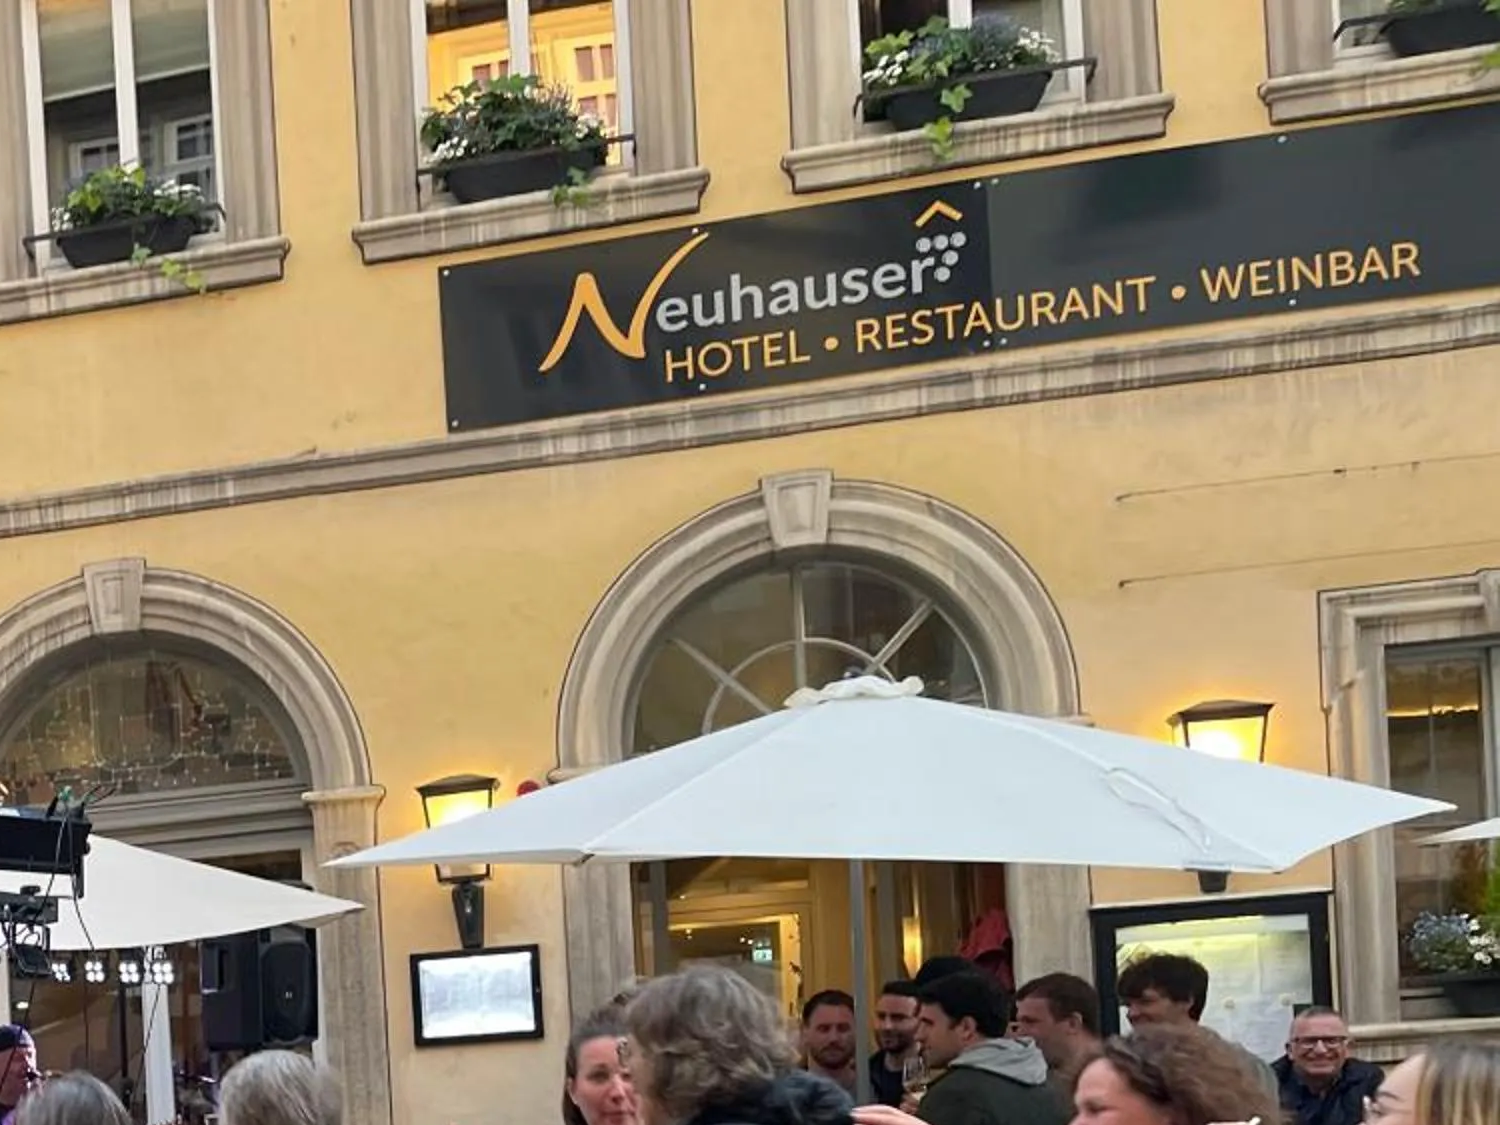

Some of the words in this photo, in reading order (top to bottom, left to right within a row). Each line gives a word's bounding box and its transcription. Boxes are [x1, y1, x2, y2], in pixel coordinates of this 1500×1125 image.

[539, 232, 936, 372] Neuhauser
[663, 333, 811, 383] HOTEL
[854, 275, 1157, 353] RESTAURANT
[1201, 242, 1422, 303] WEINBAR
